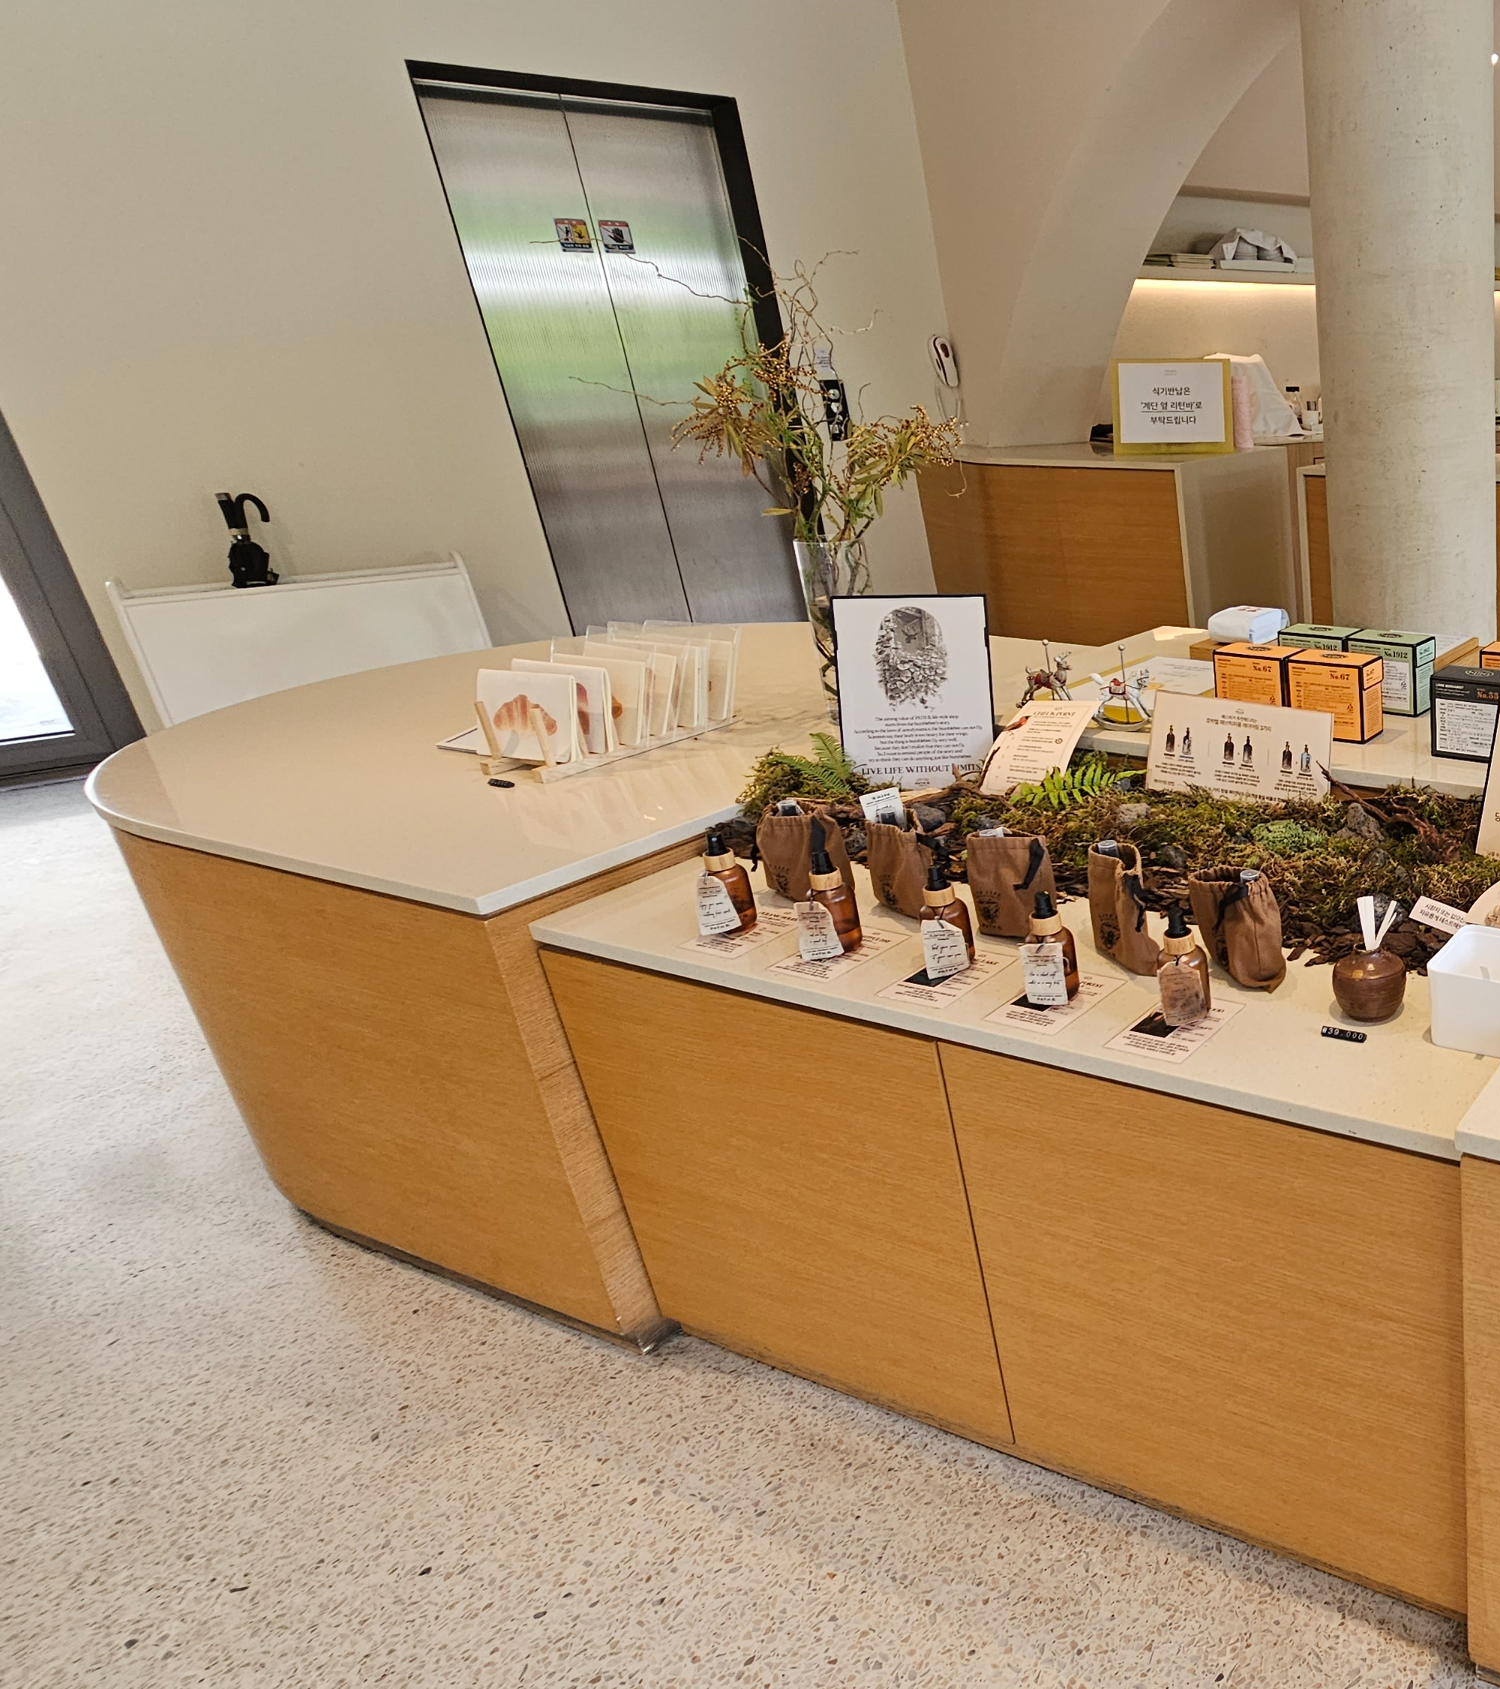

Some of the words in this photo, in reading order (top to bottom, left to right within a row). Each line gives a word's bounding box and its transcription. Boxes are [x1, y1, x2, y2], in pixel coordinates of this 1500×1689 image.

[1152, 386, 1191, 396] 식기반납은
[1150, 416, 1197, 424] 부탁드립니다
[1384, 650, 1408, 659] No.1912
[1252, 665, 1272, 673] No.67
[1329, 672, 1350, 681] No.67
[861, 767, 883, 775] LIVE
[884, 766, 905, 774] LIFE
[905, 764, 950, 773] WITHOUT
